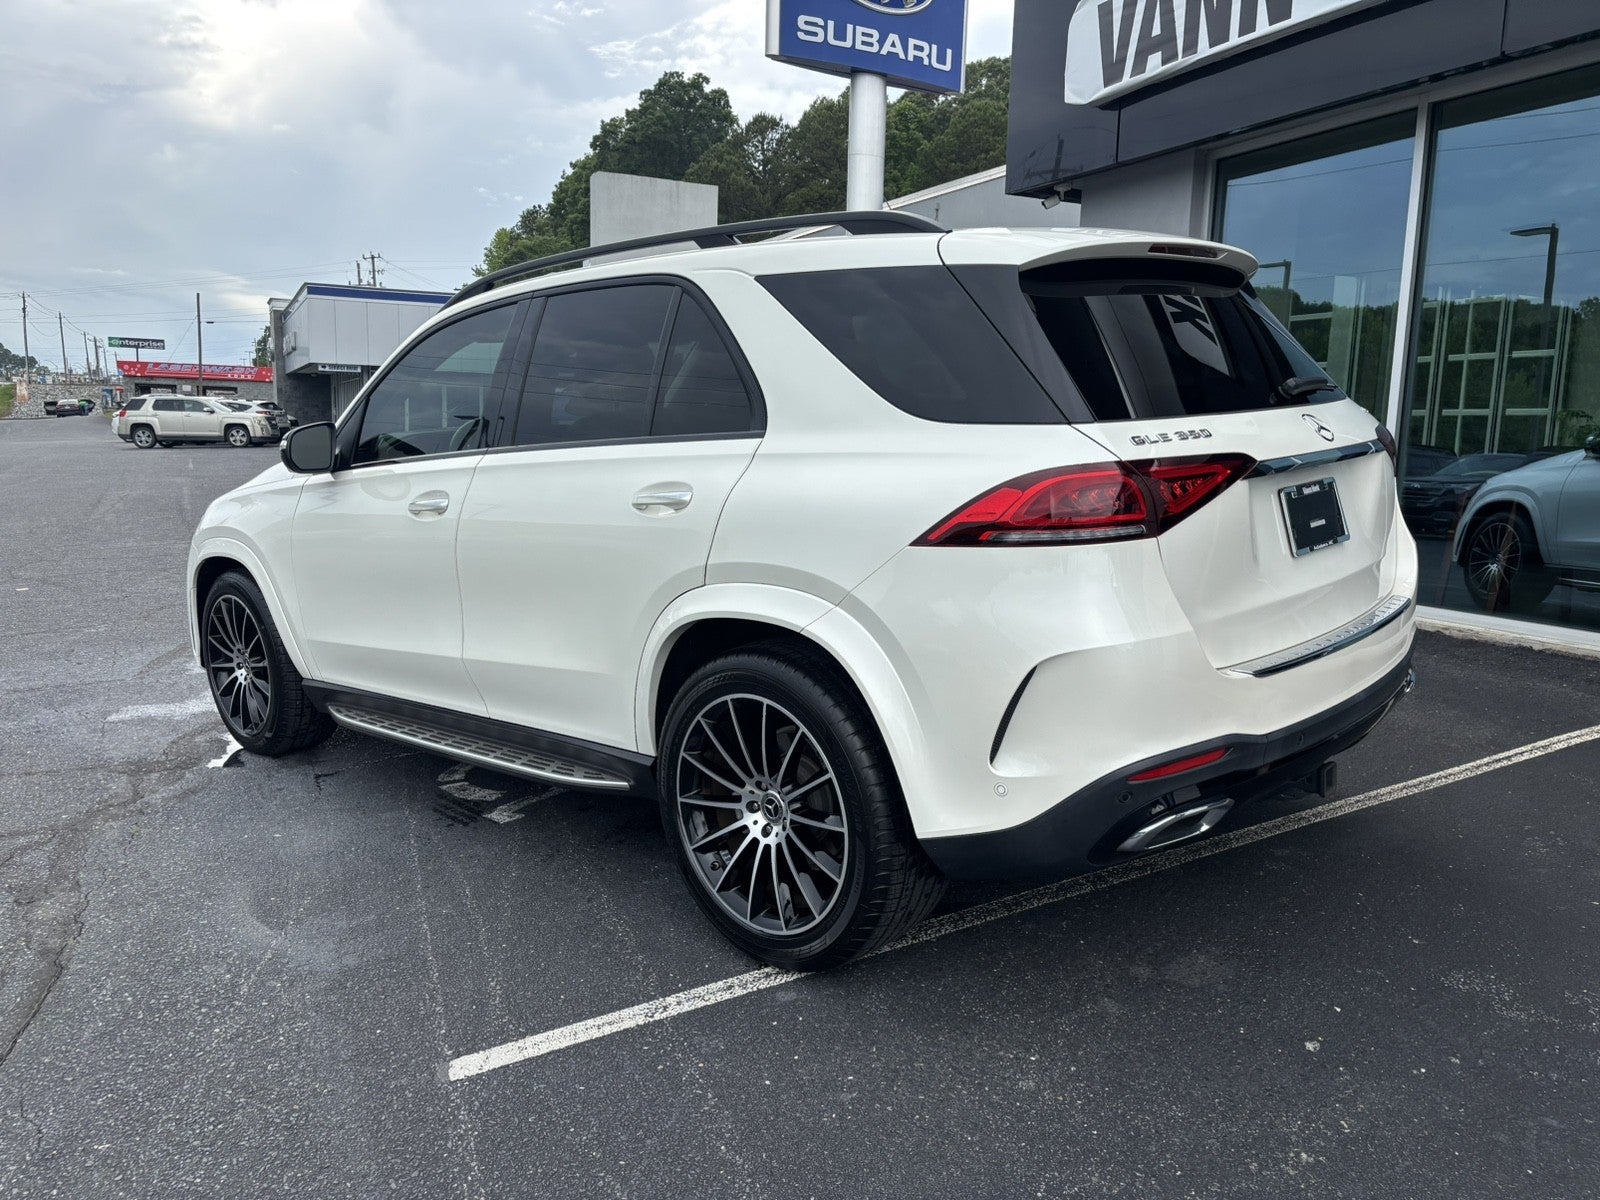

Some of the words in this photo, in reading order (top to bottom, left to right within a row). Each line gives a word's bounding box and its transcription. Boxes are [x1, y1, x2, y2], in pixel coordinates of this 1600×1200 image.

[797, 14, 952, 72] SUBARU
[111, 339, 164, 348] enterprise
[1129, 433, 1173, 446] GLE
[1174, 428, 1213, 441] 350
